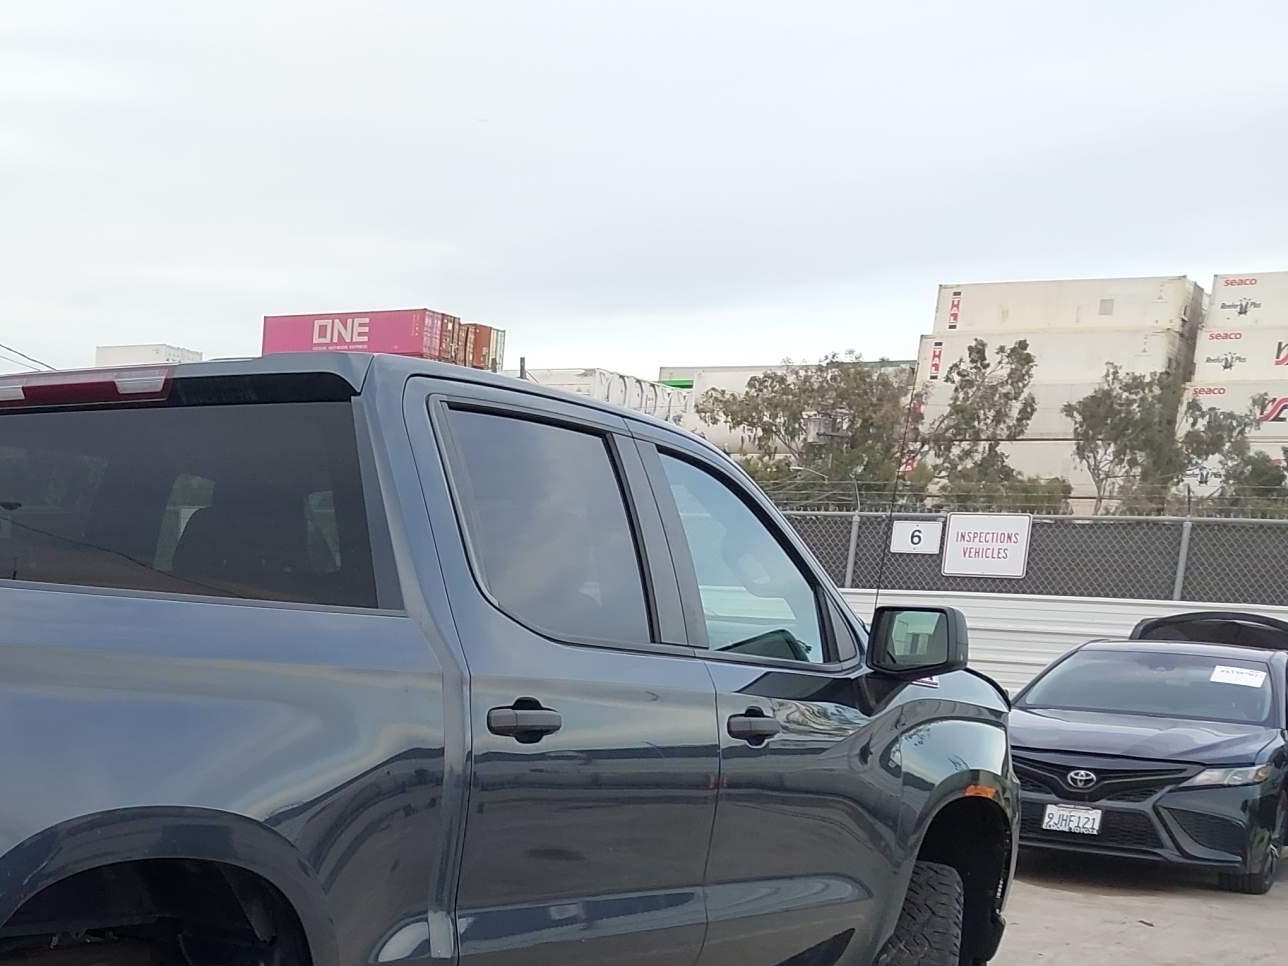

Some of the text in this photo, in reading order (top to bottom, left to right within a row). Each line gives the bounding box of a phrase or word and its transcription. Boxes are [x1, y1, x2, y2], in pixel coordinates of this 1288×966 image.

[1223, 278, 1257, 287] seaco
[312, 317, 370, 344] ONE
[1208, 331, 1243, 340] seaco
[1192, 387, 1226, 396] seaco
[910, 529, 923, 545] 6
[955, 531, 1020, 544] INSPECTIONS
[962, 547, 1009, 559] VEHICLES
